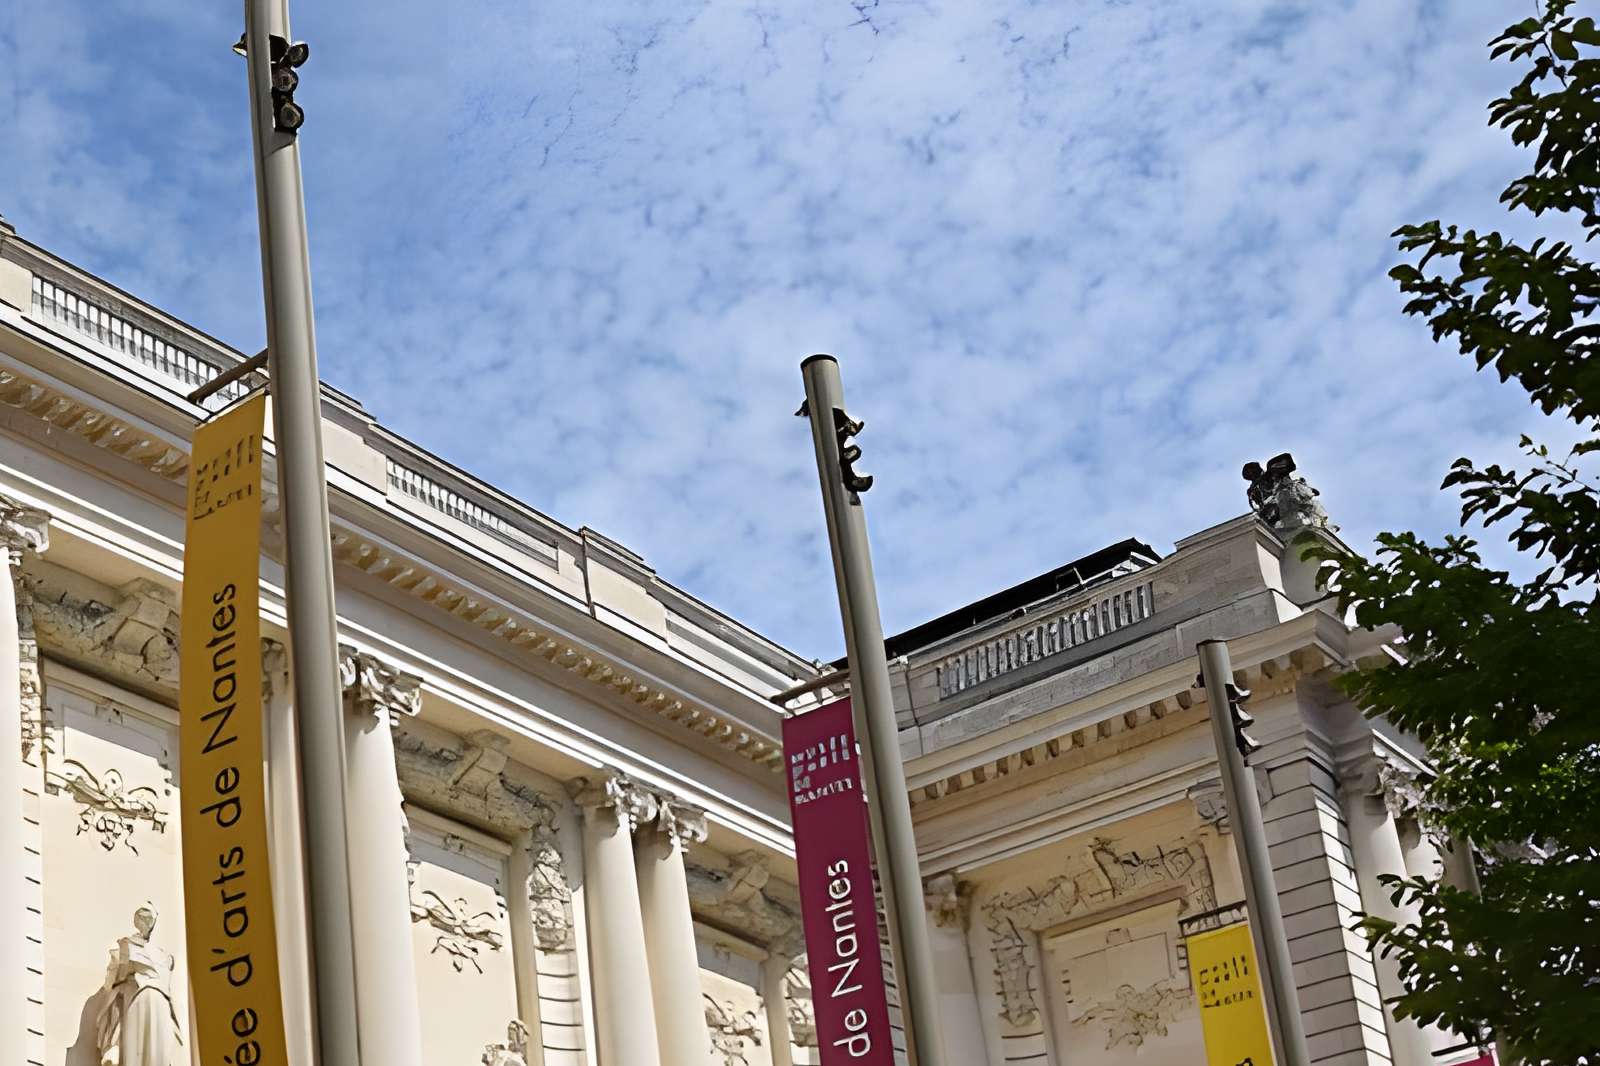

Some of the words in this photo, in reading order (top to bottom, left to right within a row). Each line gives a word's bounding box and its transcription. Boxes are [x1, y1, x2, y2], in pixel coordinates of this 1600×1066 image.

[200, 583, 238, 754] Nantes
[200, 766, 241, 827] de
[210, 846, 252, 986] d'arts
[825, 859, 863, 997] Nantes
[833, 1008, 870, 1057] de
